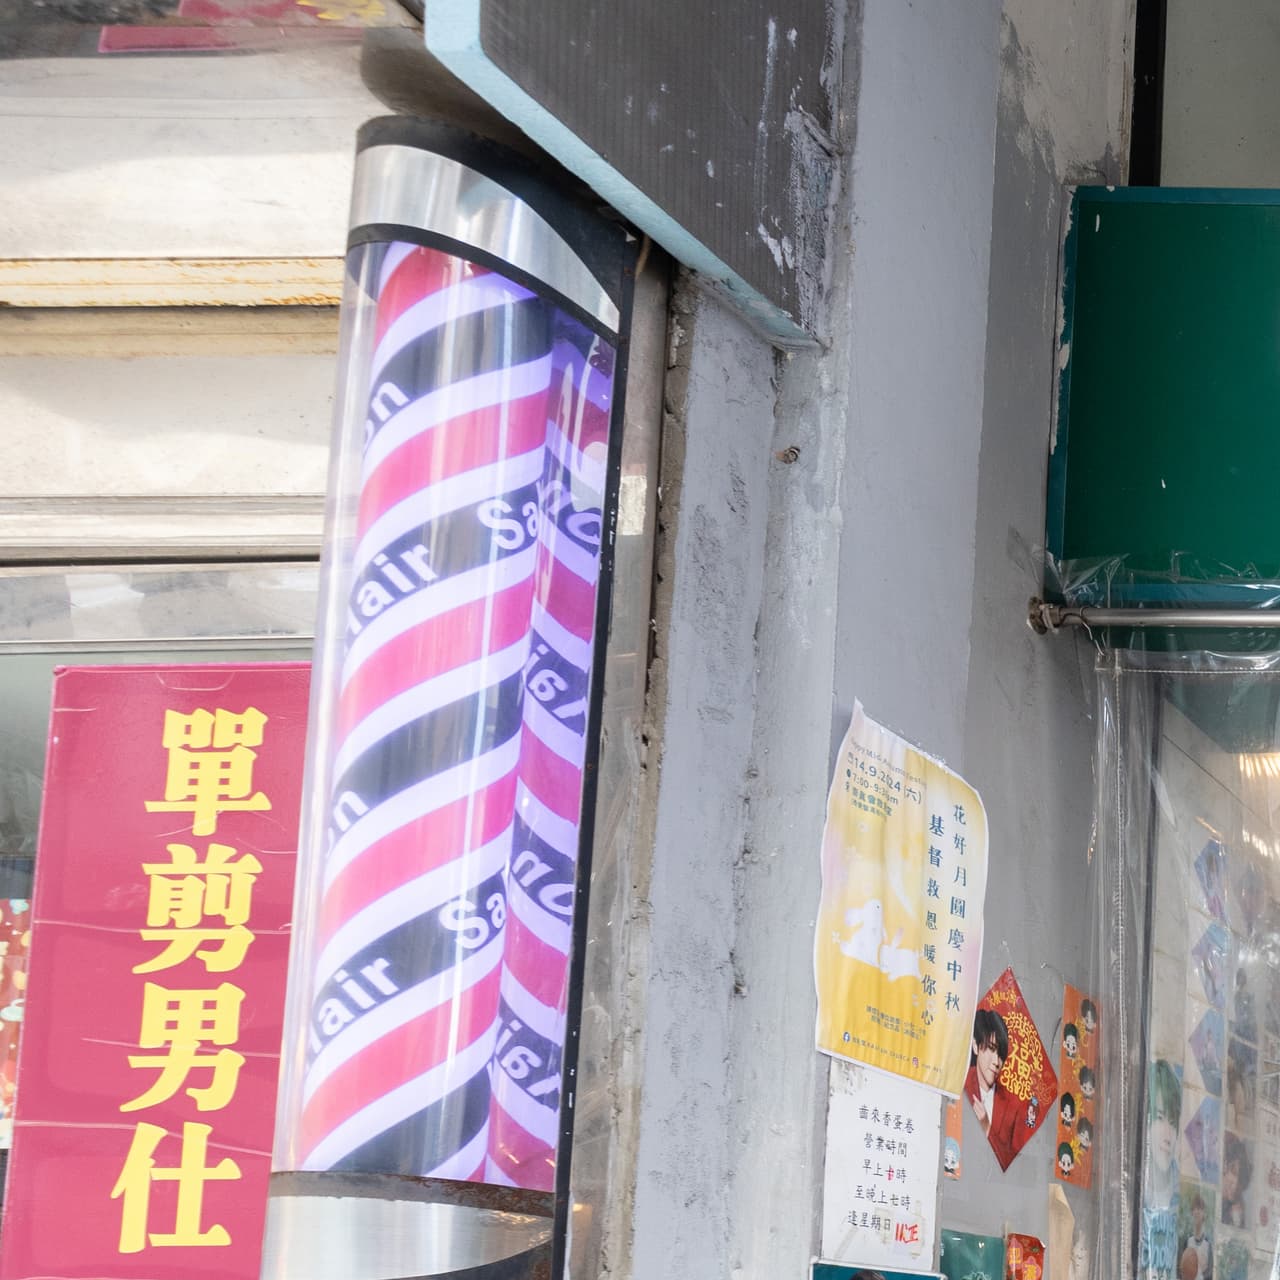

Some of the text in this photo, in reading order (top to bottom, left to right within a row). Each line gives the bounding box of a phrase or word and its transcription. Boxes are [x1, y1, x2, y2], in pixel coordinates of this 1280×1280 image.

[110, 705, 272, 1254] 單剪男仕
[921, 813, 945, 1026] 基督救恩暖你心
[945, 804, 968, 1012] 花好月圓慶中秋
